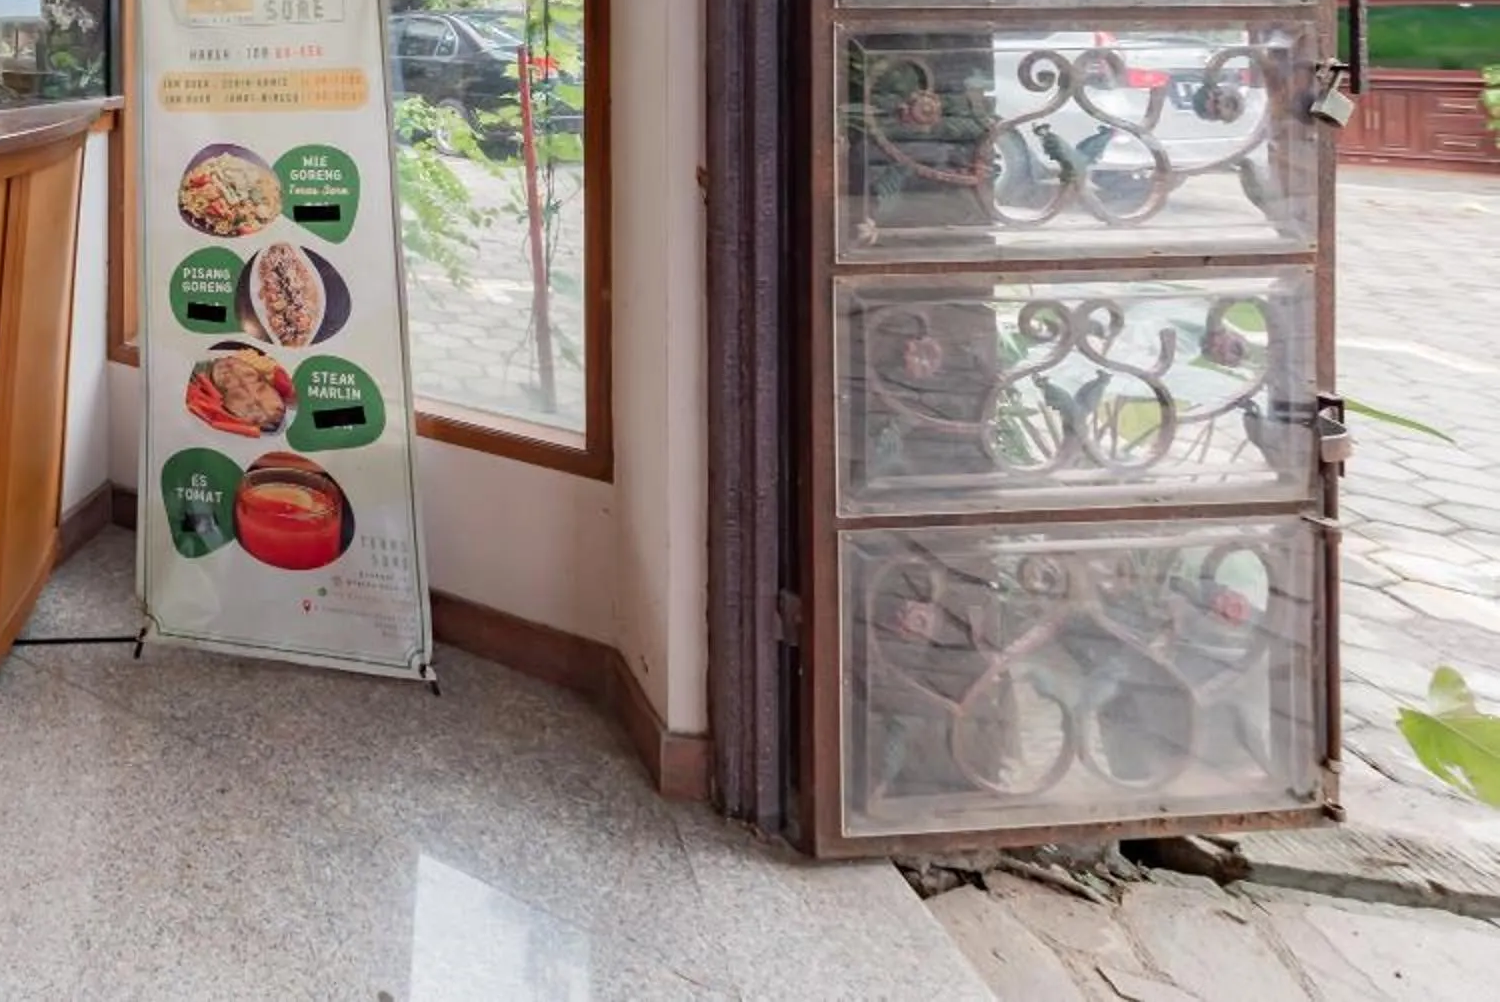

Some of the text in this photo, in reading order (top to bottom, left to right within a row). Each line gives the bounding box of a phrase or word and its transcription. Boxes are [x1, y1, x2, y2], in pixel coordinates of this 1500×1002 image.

[303, 155, 328, 167] MIE
[290, 169, 342, 181] GORENG
[183, 267, 231, 280] PISANG
[182, 280, 233, 293] GORENG
[311, 371, 356, 385] STEAK
[307, 385, 362, 400] MARLIN
[192, 473, 208, 487] ES
[176, 487, 224, 503] TOMAT
